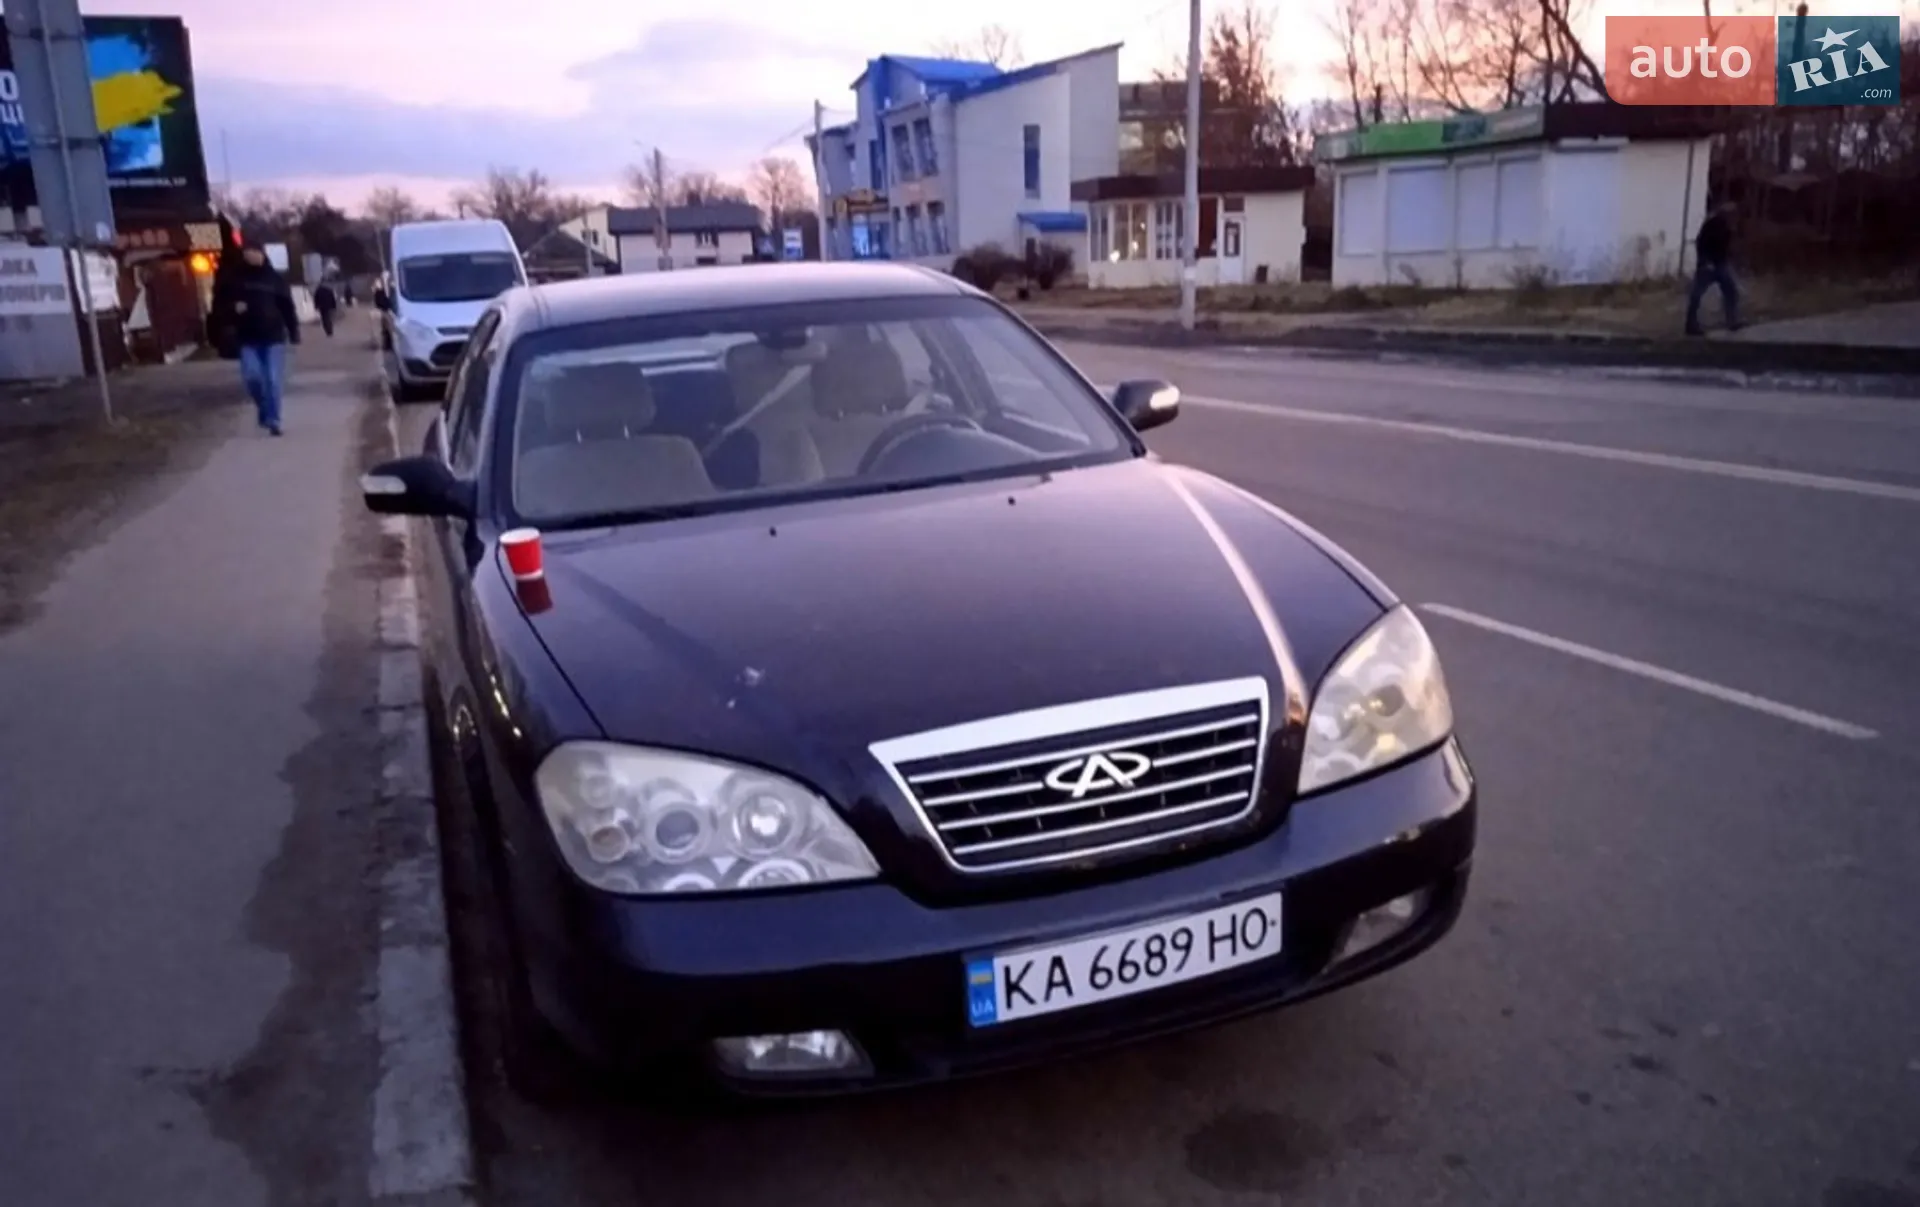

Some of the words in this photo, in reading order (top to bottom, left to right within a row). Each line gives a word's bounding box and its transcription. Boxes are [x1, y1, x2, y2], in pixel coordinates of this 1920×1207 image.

[1004, 954, 1074, 1011] KA
[1088, 926, 1195, 992] 6689
[1207, 907, 1269, 963] HO
[971, 999, 994, 1018] UA
